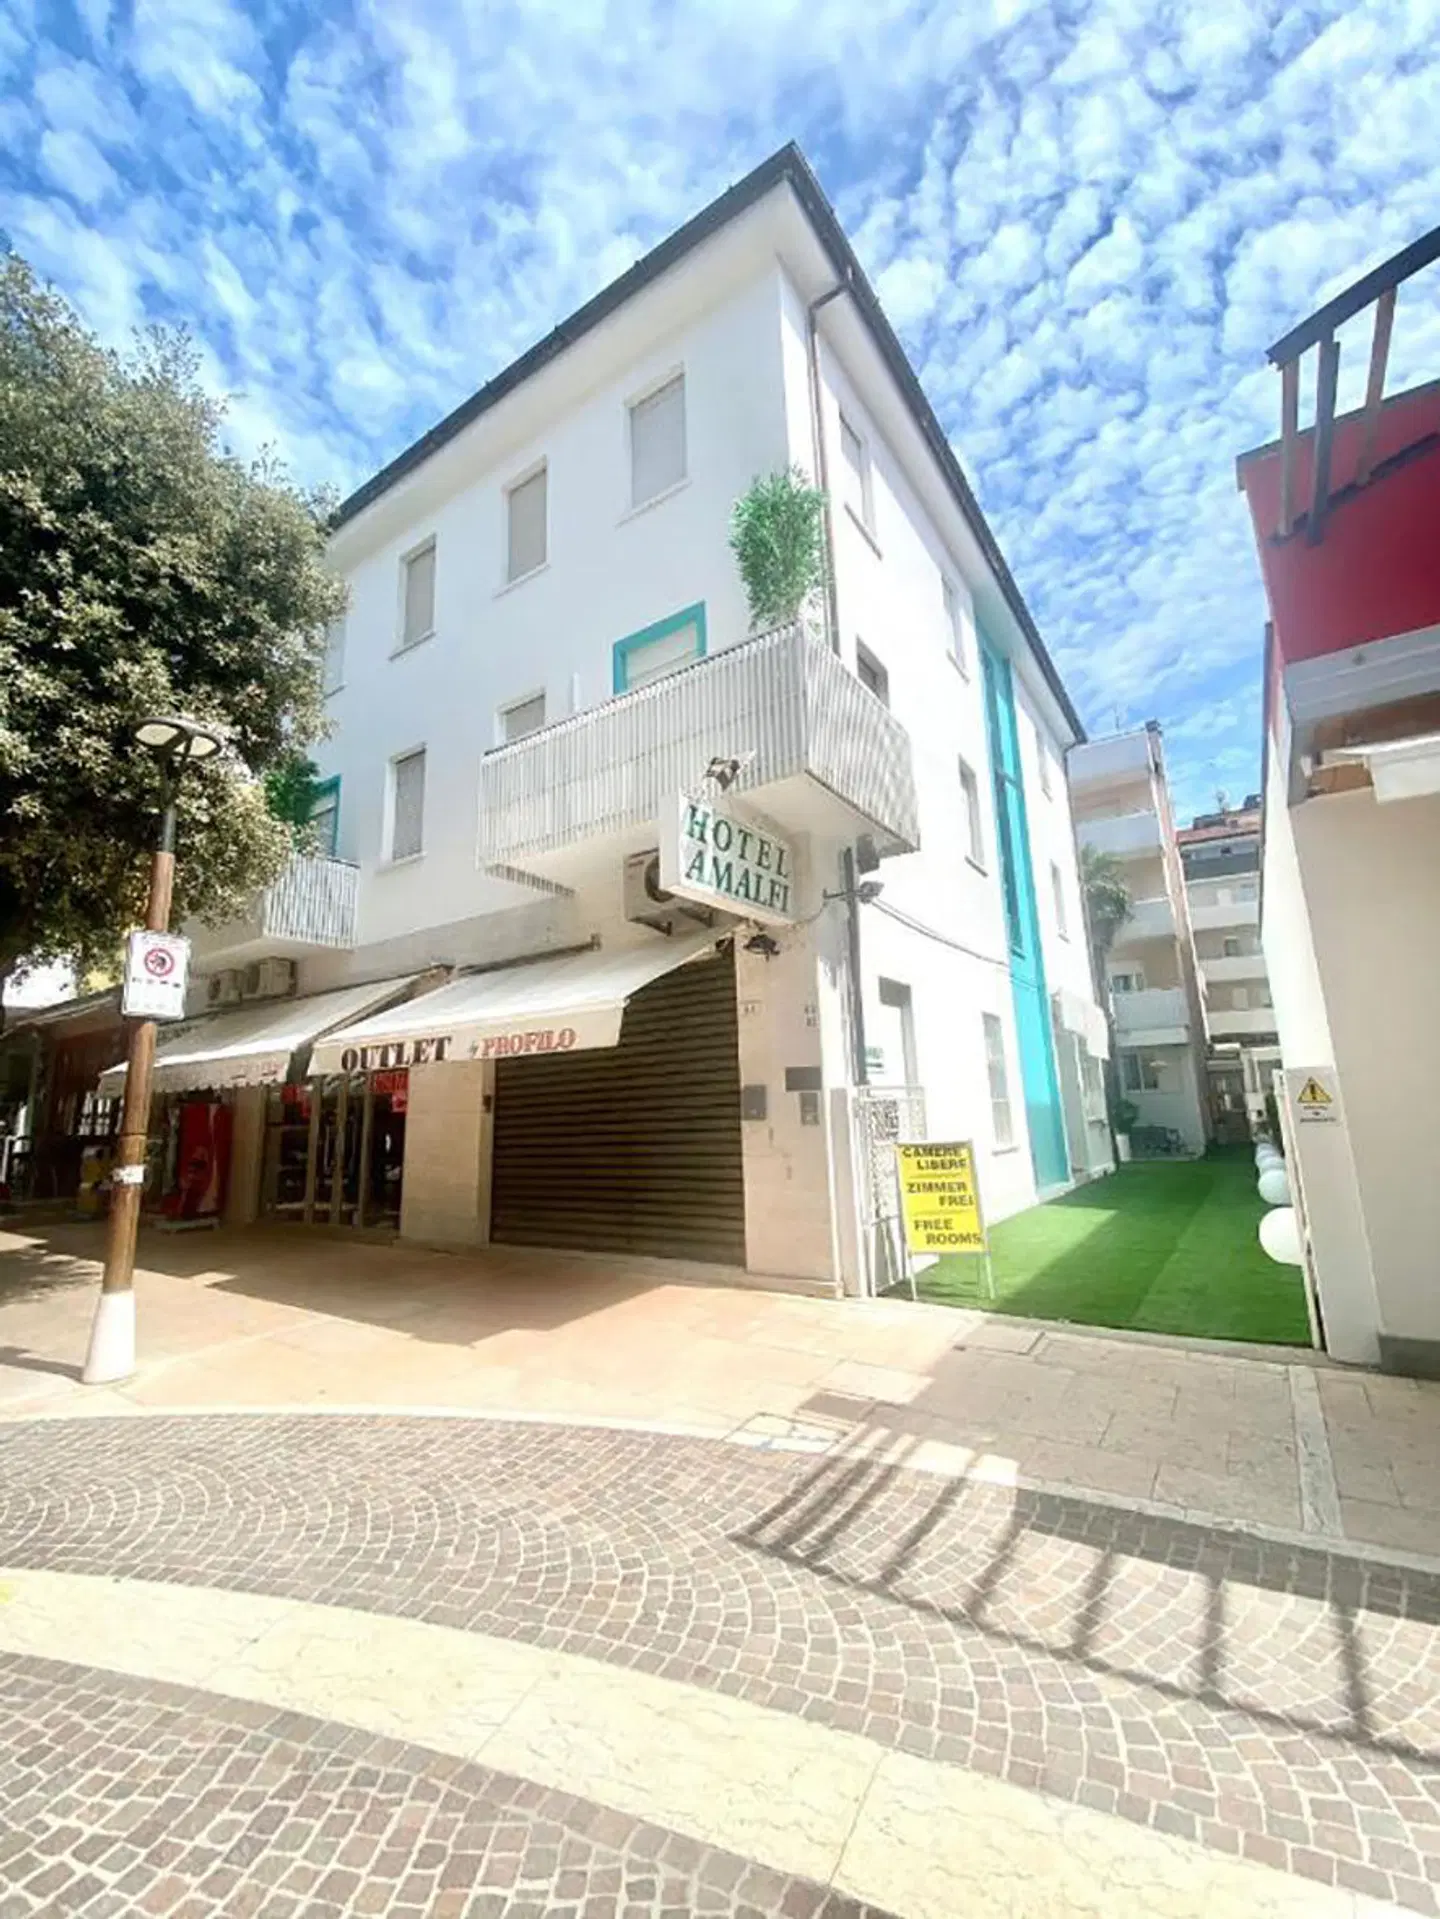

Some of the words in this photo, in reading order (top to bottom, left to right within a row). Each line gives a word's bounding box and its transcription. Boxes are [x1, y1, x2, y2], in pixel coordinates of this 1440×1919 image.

[687, 804, 791, 879] HOTEL
[684, 849, 791, 913] AMALFI
[341, 1036, 452, 1071] OUTLET
[481, 1028, 577, 1057] PROFILO
[902, 1145, 961, 1158] CAMERE
[916, 1159, 967, 1170] LIBERE
[907, 1182, 968, 1193] ZIMMER
[939, 1195, 974, 1206] FREI
[913, 1219, 954, 1230] FREE
[926, 1233, 982, 1245] ROOMS
